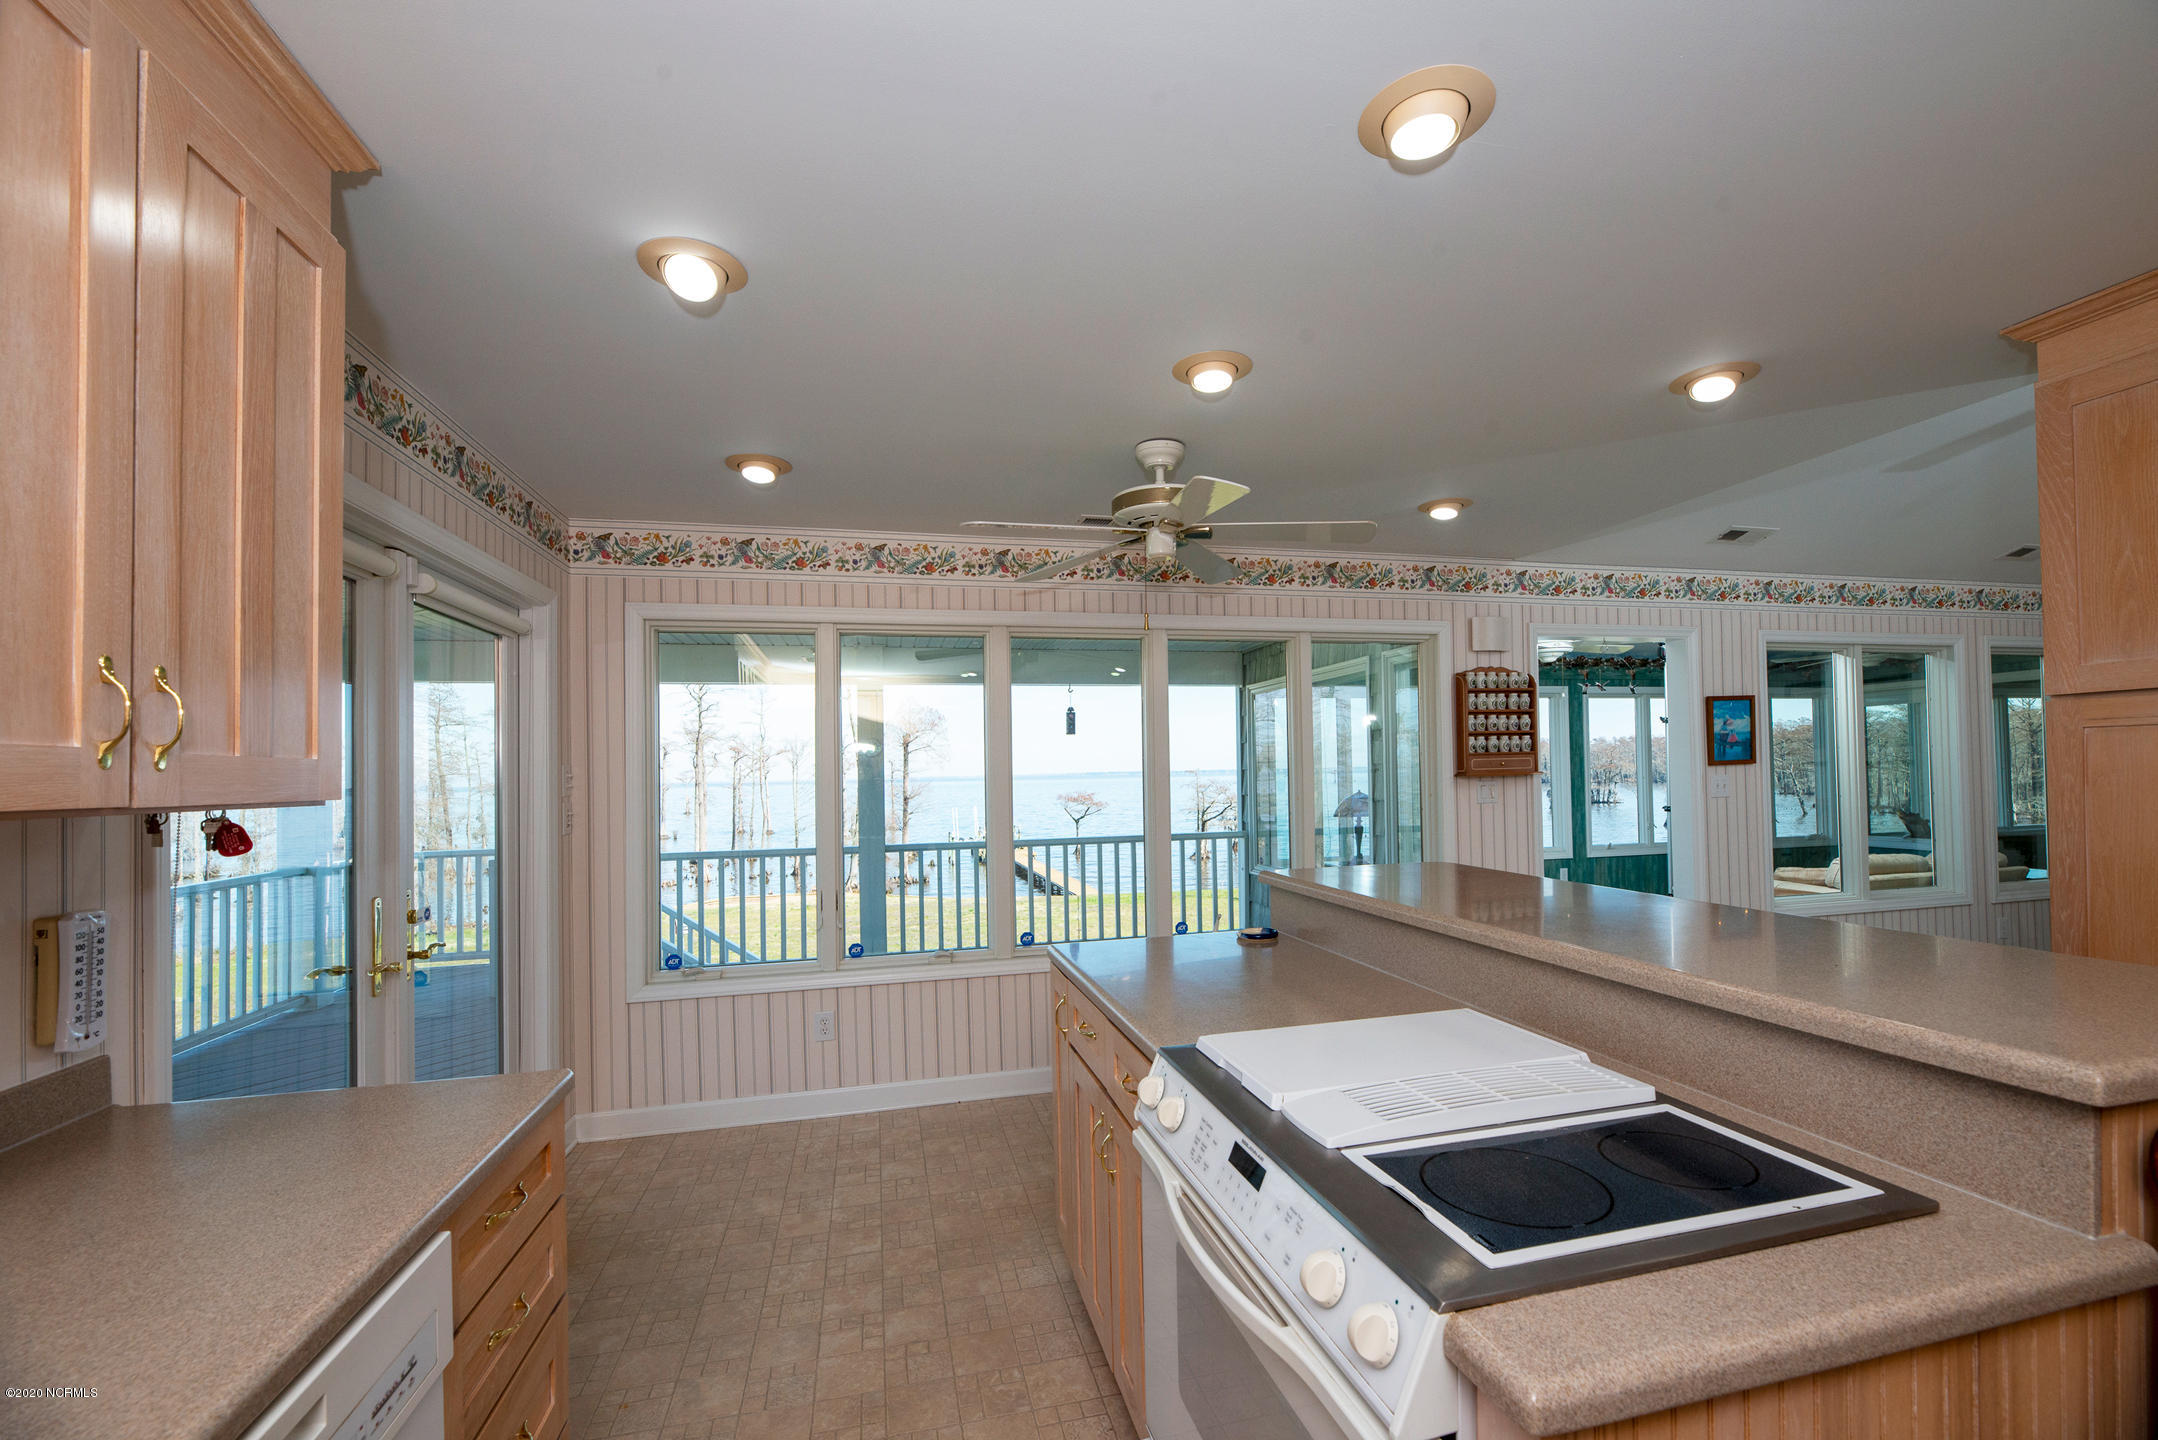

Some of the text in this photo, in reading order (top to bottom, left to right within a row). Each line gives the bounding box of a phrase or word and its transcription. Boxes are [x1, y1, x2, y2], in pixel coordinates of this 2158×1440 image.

[97, 927, 105, 935] 50
[75, 943, 86, 952] 100
[96, 948, 105, 956] 30
[96, 958, 104, 966] 20
[75, 967, 84, 976] 60
[96, 968, 104, 976] 10
[75, 979, 83, 987] 40
[97, 979, 102, 987] 0
[75, 1003, 81, 1011] 0
[95, 1000, 104, 1008] 20
[74, 1015, 83, 1024] 20
